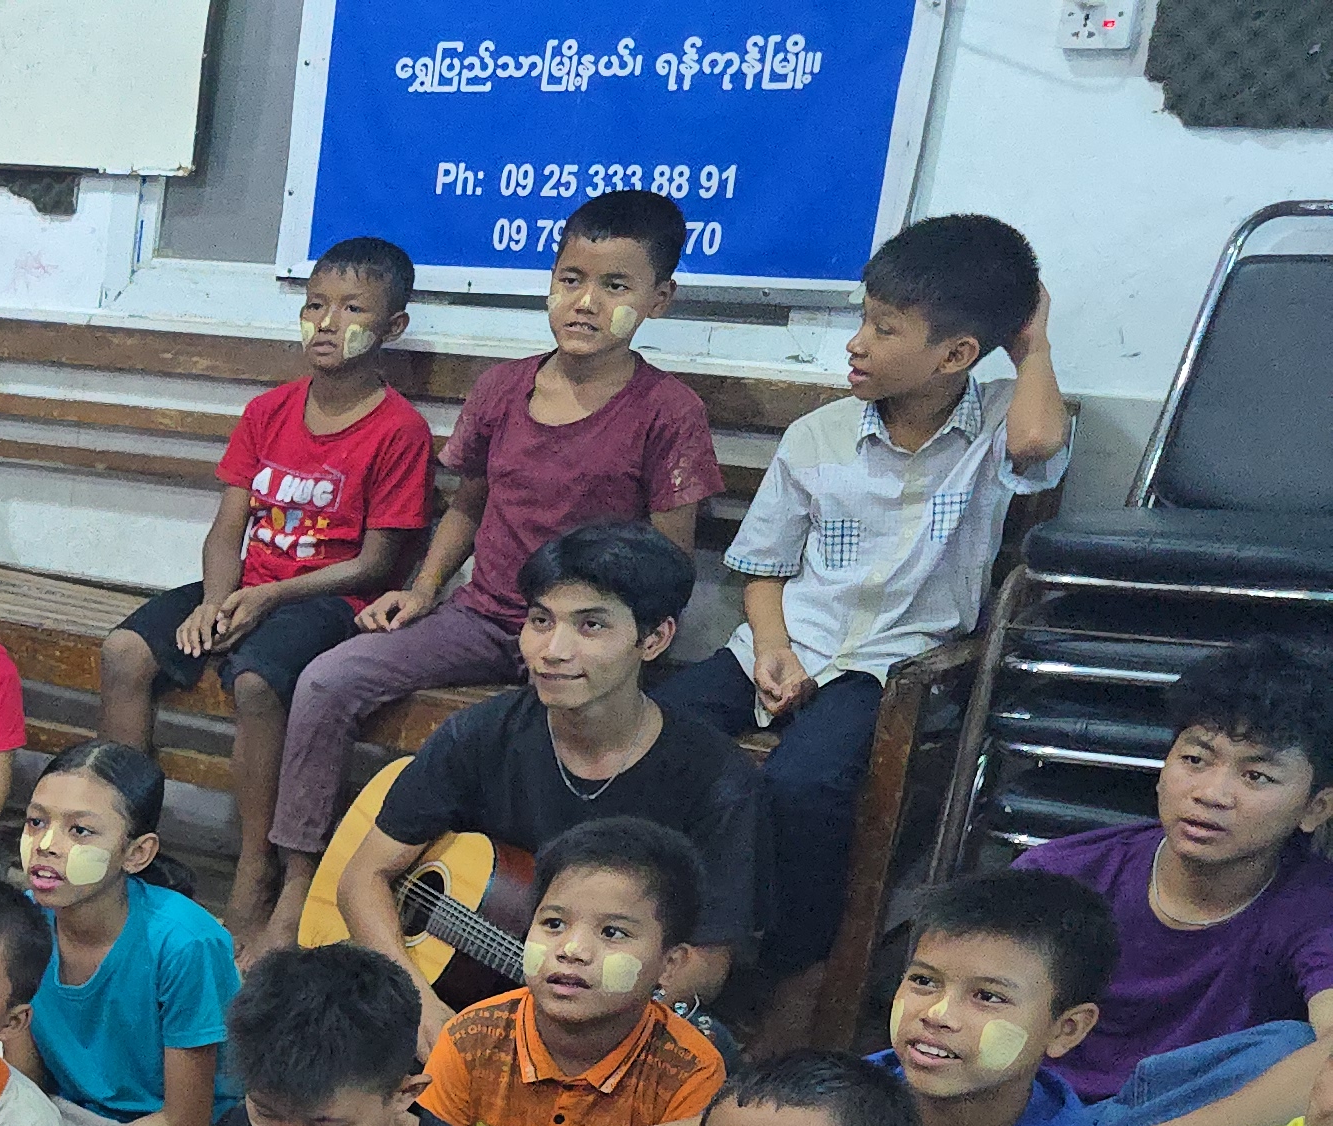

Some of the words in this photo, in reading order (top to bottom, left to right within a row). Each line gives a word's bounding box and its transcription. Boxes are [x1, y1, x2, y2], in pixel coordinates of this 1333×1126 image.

[436, 162, 485, 195] Ph:
[500, 163, 534, 197] 09
[540, 164, 579, 197] 25
[586, 164, 643, 198] 333
[650, 165, 690, 198] 88
[699, 164, 738, 199] 91
[493, 218, 528, 251] 09
[685, 222, 722, 255] 70
[252, 467, 273, 495] A
[276, 474, 334, 508] HUG
